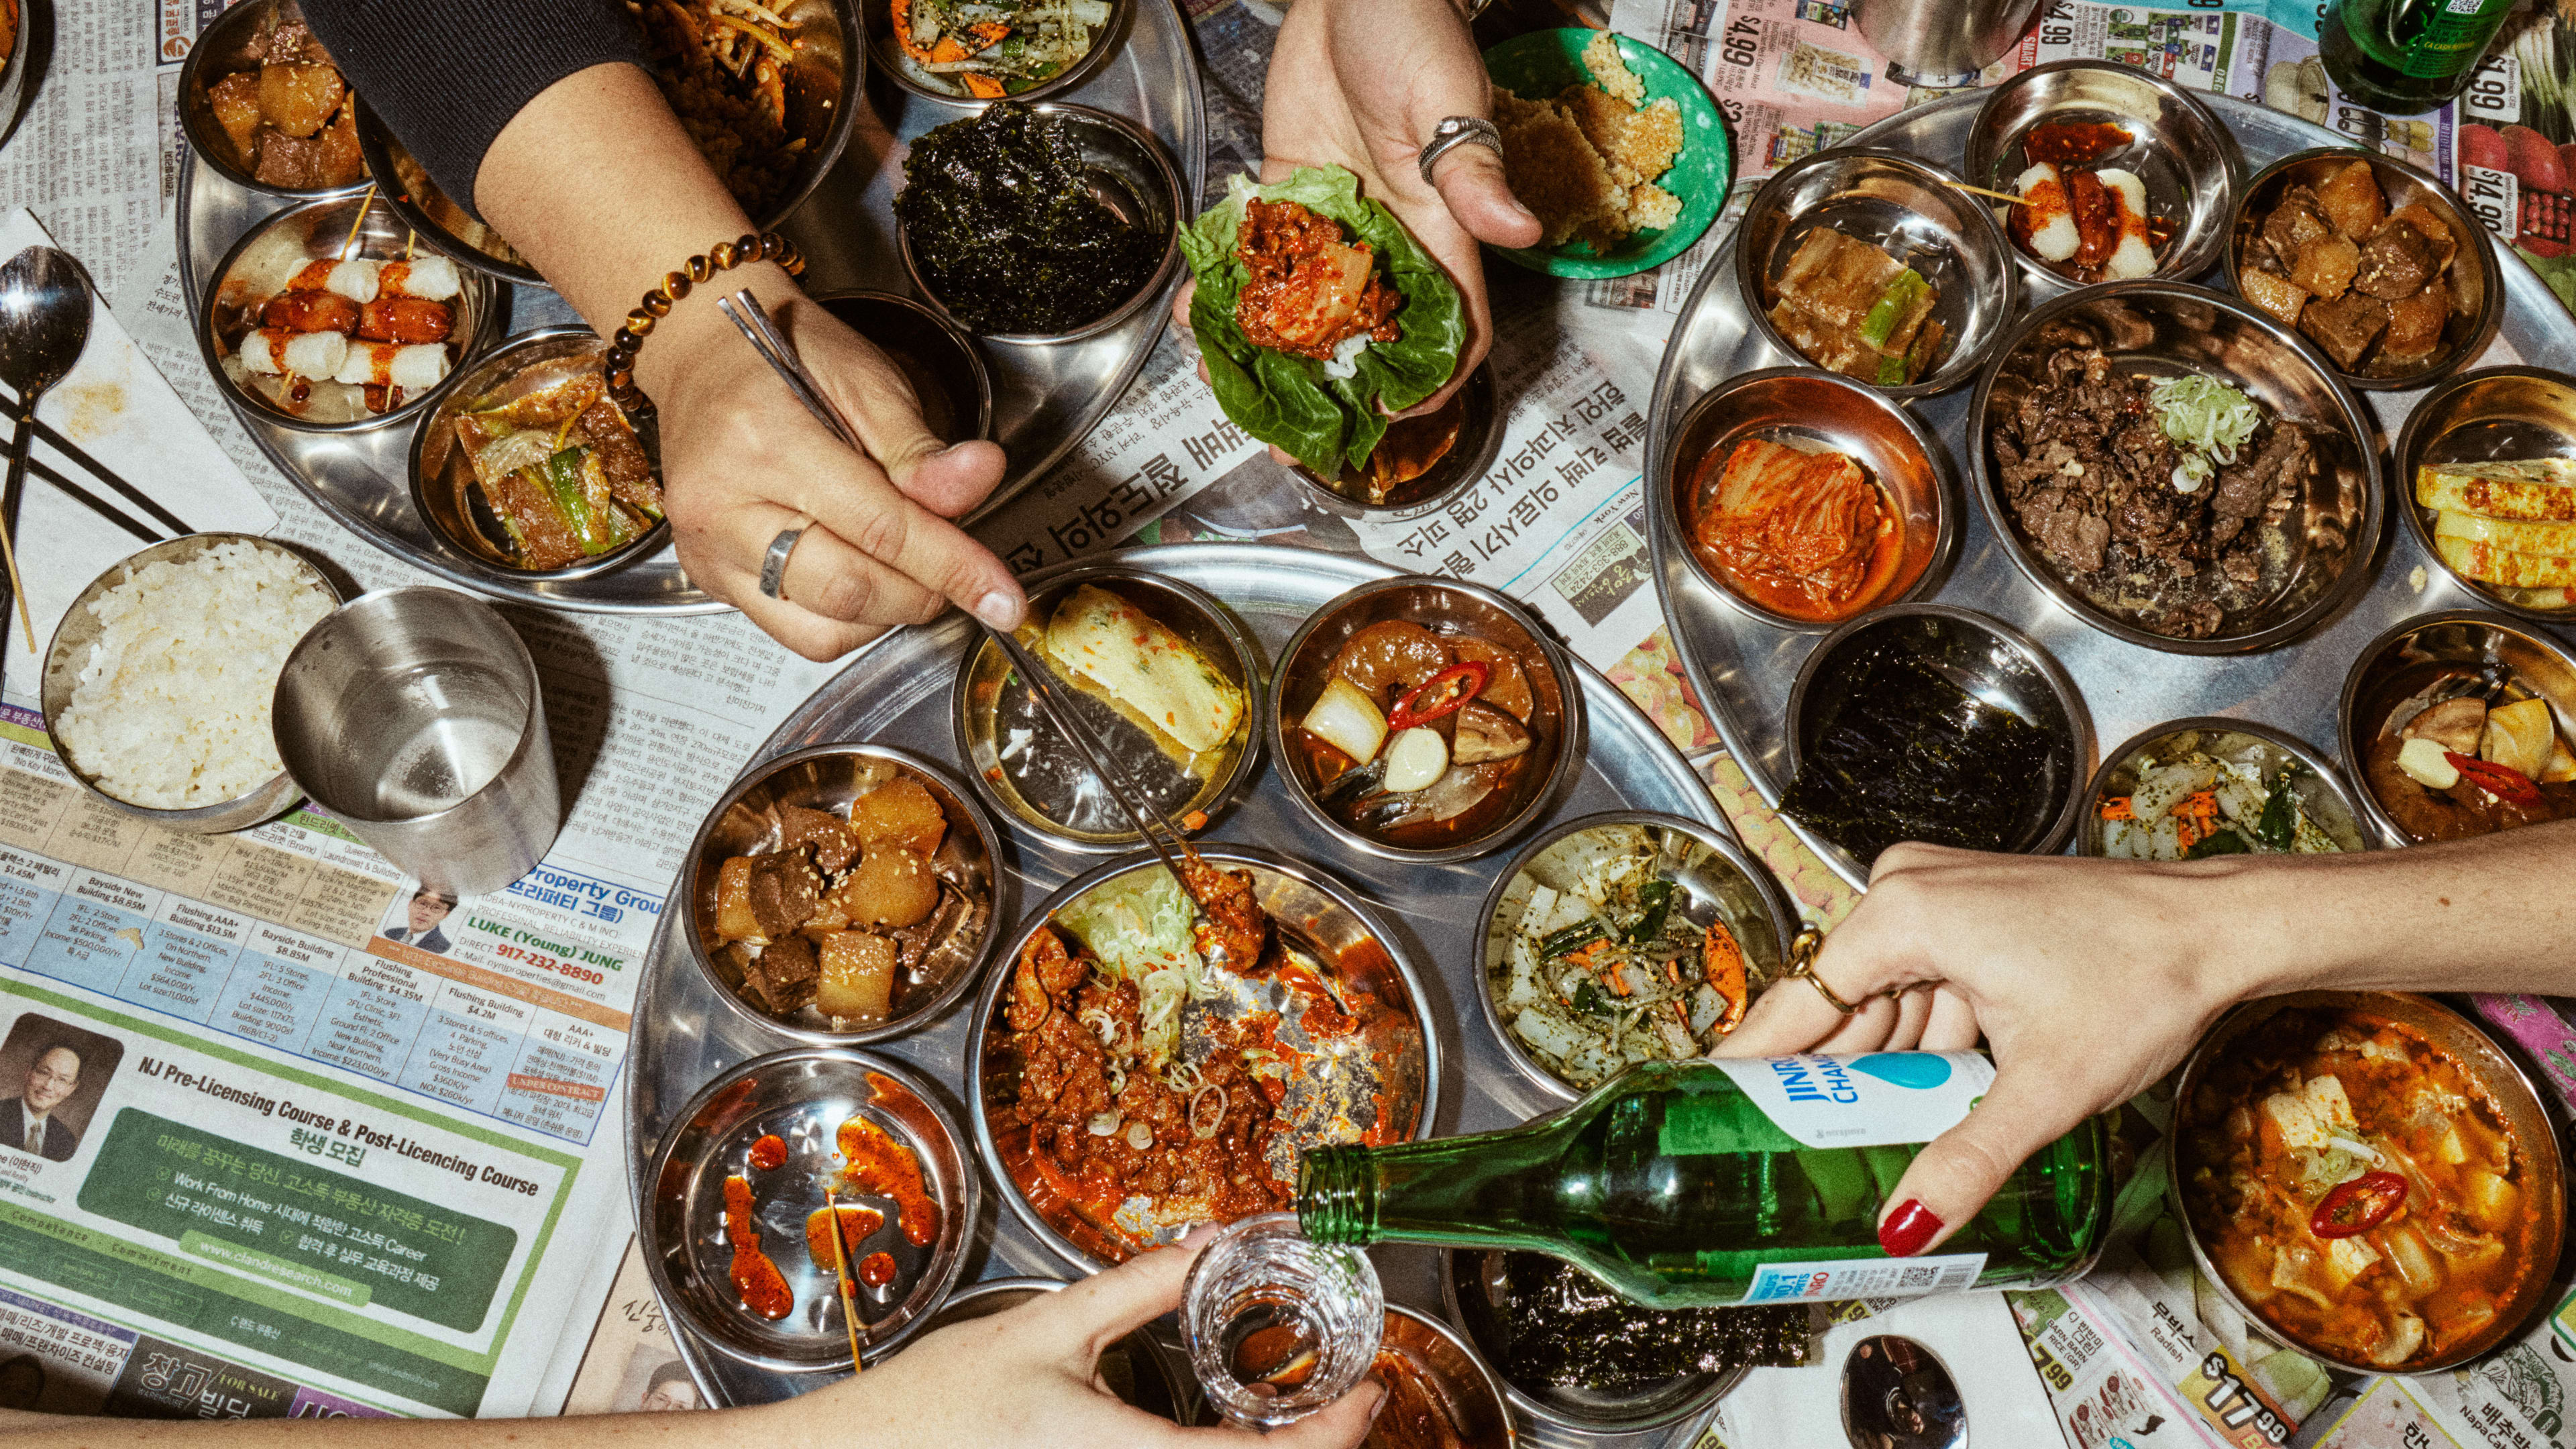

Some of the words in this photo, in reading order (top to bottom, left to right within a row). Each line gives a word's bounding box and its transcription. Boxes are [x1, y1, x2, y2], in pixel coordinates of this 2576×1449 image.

[1721, 13, 1761, 68] $4.99
[2040, 1, 2076, 48] $4.99
[2020, 35, 2036, 66] SMART
[2468, 54, 2506, 111] $1.99
[1572, 380, 1624, 425] 한인
[1486, 415, 1576, 494] 치과의사
[1556, 446, 1607, 488] 킥백
[1048, 453, 1188, 558] 절도와의
[1446, 494, 1489, 529] 2명
[1595, 506, 1617, 523] York
[1619, 492, 1638, 504] New
[1471, 480, 1556, 561] 의료사기
[1397, 520, 1450, 557] 피소
[1570, 541, 1628, 592] 888-353-2424
[6, 865, 36, 882] $1.45M
[322, 849, 362, 870] Laundromat
[369, 863, 400, 882] Building
[76, 885, 113, 904] Building
[111, 896, 146, 914] $8.85M
[87, 877, 124, 896] Bayside
[124, 888, 145, 898] New
[506, 880, 580, 912] 프라퍼티
[580, 897, 624, 926] 그룹)
[616, 892, 663, 914] Grou
[168, 911, 206, 932] Building
[205, 924, 238, 943] $13.5M
[176, 904, 215, 923] Flushing
[215, 916, 233, 926] AAA+
[260, 930, 298, 949] Bayside
[297, 941, 335, 961] Building
[274, 947, 311, 964] $8.85M
[466, 918, 510, 940] LUKE
[515, 932, 576, 961] (Young)
[578, 951, 625, 975] JUNG
[363, 966, 419, 990] Professional
[374, 961, 414, 978] Flushing
[458, 941, 494, 956] DIRECT:
[494, 942, 605, 987] 917-232-8890
[282, 981, 306, 993] Office
[346, 971, 388, 993] Building:
[390, 985, 424, 1000] $4.35M
[486, 959, 606, 1004] nynjproperties@gmail.com
[447, 988, 487, 1006] Flushing
[486, 1000, 525, 1018] Building
[468, 1006, 495, 1022] $4.2M
[329, 1016, 358, 1030] Ground
[368, 1030, 376, 1039] 2
[375, 1033, 401, 1046] Office
[333, 1031, 350, 1043] New
[436, 1016, 443, 1026] 3
[443, 1017, 468, 1033] Stores
[475, 1028, 482, 1038] 5
[570, 1025, 588, 1035] AAA+
[427, 1049, 449, 1063] (Very
[447, 1053, 471, 1069] Busy
[472, 1061, 488, 1073] Area)
[562, 1035, 583, 1049] 리커
[591, 1042, 612, 1059] 빌딩
[313, 1049, 339, 1063] Income:
[342, 1057, 391, 1080] $223,000/yr
[431, 1075, 471, 1093] $360K/yr
[513, 1071, 545, 1094] UNDER
[549, 1075, 598, 1106] CONTRACT
[136, 1053, 164, 1081] NJ
[164, 1065, 274, 1116] Pre-Licensing
[276, 1099, 337, 1135] Course
[335, 1118, 354, 1140] &
[355, 1125, 478, 1183] Post-Licencing
[479, 1163, 541, 1199] Course
[287, 1125, 328, 1157] 학생
[323, 1136, 366, 1170] 모집
[154, 1130, 200, 1163] 미래를
[203, 1146, 250, 1177] 꿈꾸는
[284, 1175, 329, 1203] 고소득
[328, 1189, 376, 1220] 부동산
[376, 1201, 426, 1233] 자격증
[166, 1189, 193, 1214] 신규
[189, 1198, 240, 1230] 라이센스
[237, 1214, 266, 1238] 취득
[172, 1169, 207, 1193] Work
[204, 1179, 239, 1204] From
[236, 1189, 274, 1216] Home
[272, 1201, 311, 1228] 시대에
[309, 1212, 350, 1240] 적합한
[345, 1223, 387, 1250] 고소득
[384, 1241, 428, 1264] Career
[13, 1212, 90, 1244] Competence
[113, 1244, 194, 1278] Commitment
[200, 1242, 352, 1298] www.clandresearch.com
[296, 1232, 325, 1256] 합격
[322, 1241, 339, 1260] 후
[337, 1246, 365, 1269] 실무
[362, 1254, 414, 1285] 교육과정
[411, 1271, 441, 1294] 제공
[2044, 1322, 2070, 1341] BARN
[2065, 1342, 2091, 1362] BARN
[2065, 1311, 2081, 1322] CJ
[2080, 1318, 2108, 1344] 반반미
[2069, 1334, 2092, 1350] (그린)
[2146, 1302, 2194, 1356] 무박스
[2046, 1336, 2068, 1354] RICE
[2061, 1357, 2078, 1368] (GR)
[2151, 1327, 2186, 1364] Radish
[141, 1354, 211, 1401] 창고
[221, 1375, 245, 1393] FOR
[250, 1385, 276, 1399] SALE
[2456, 1406, 2493, 1438] Napa
